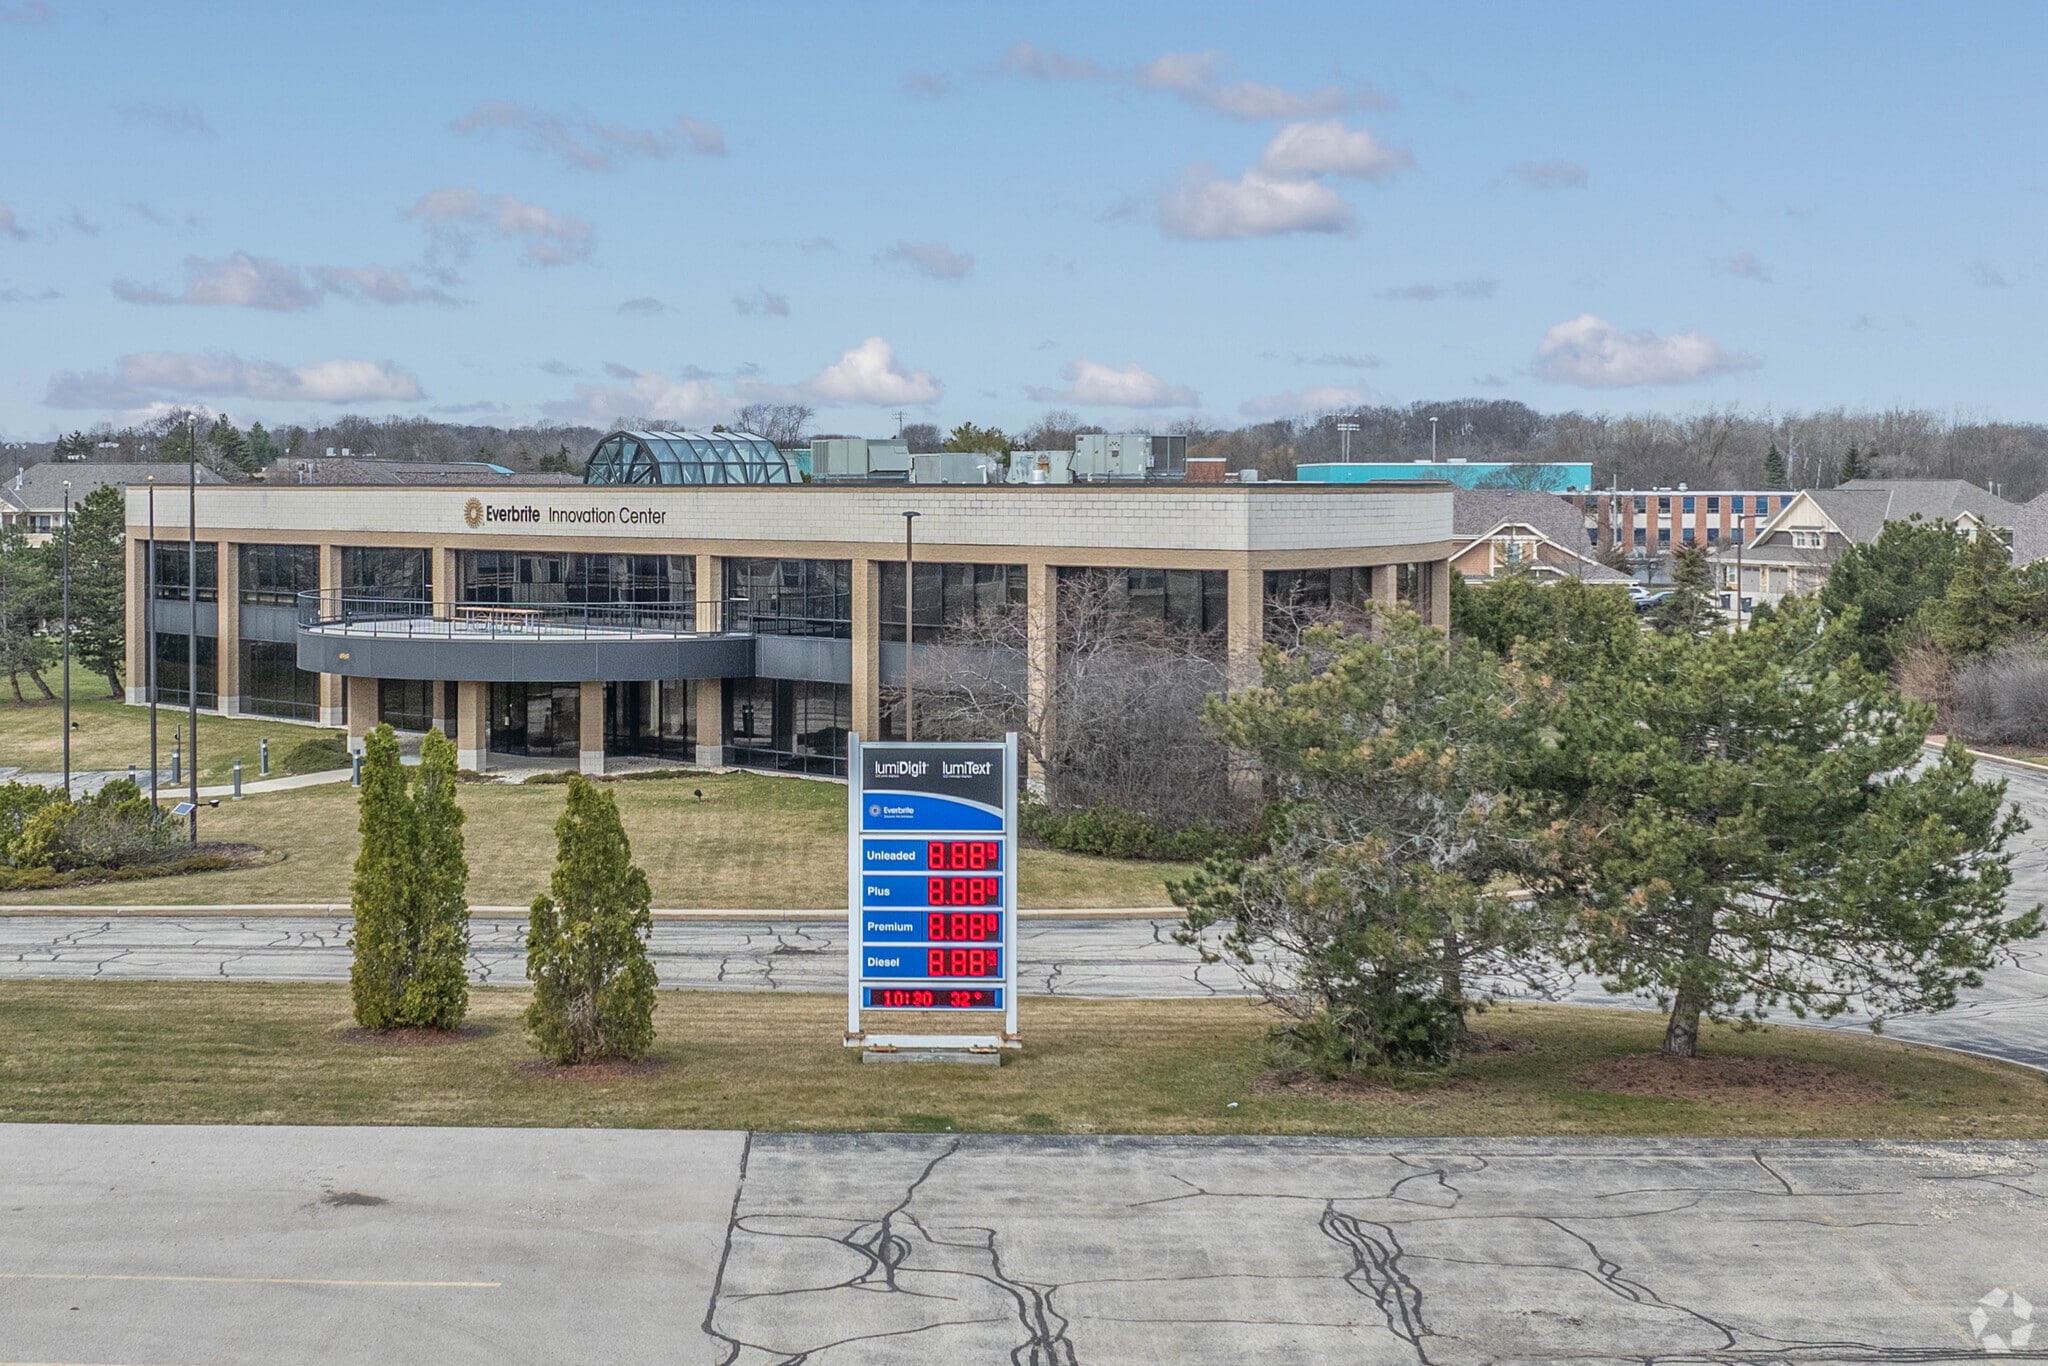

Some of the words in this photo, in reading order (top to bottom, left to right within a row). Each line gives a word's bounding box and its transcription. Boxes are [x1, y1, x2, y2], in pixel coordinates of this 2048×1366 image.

[486, 505, 540, 523] Everbrite
[549, 507, 615, 524] Innovation
[619, 507, 666, 524] Center
[875, 761, 927, 778] lumiDigit
[942, 761, 991, 775] lumiText
[883, 806, 914, 815] Everbrite
[867, 850, 916, 861] Unleaded
[867, 886, 890, 897] Plus
[867, 922, 913, 932] Premium
[867, 957, 900, 967] Diesel
[883, 990, 933, 1007] 10:30
